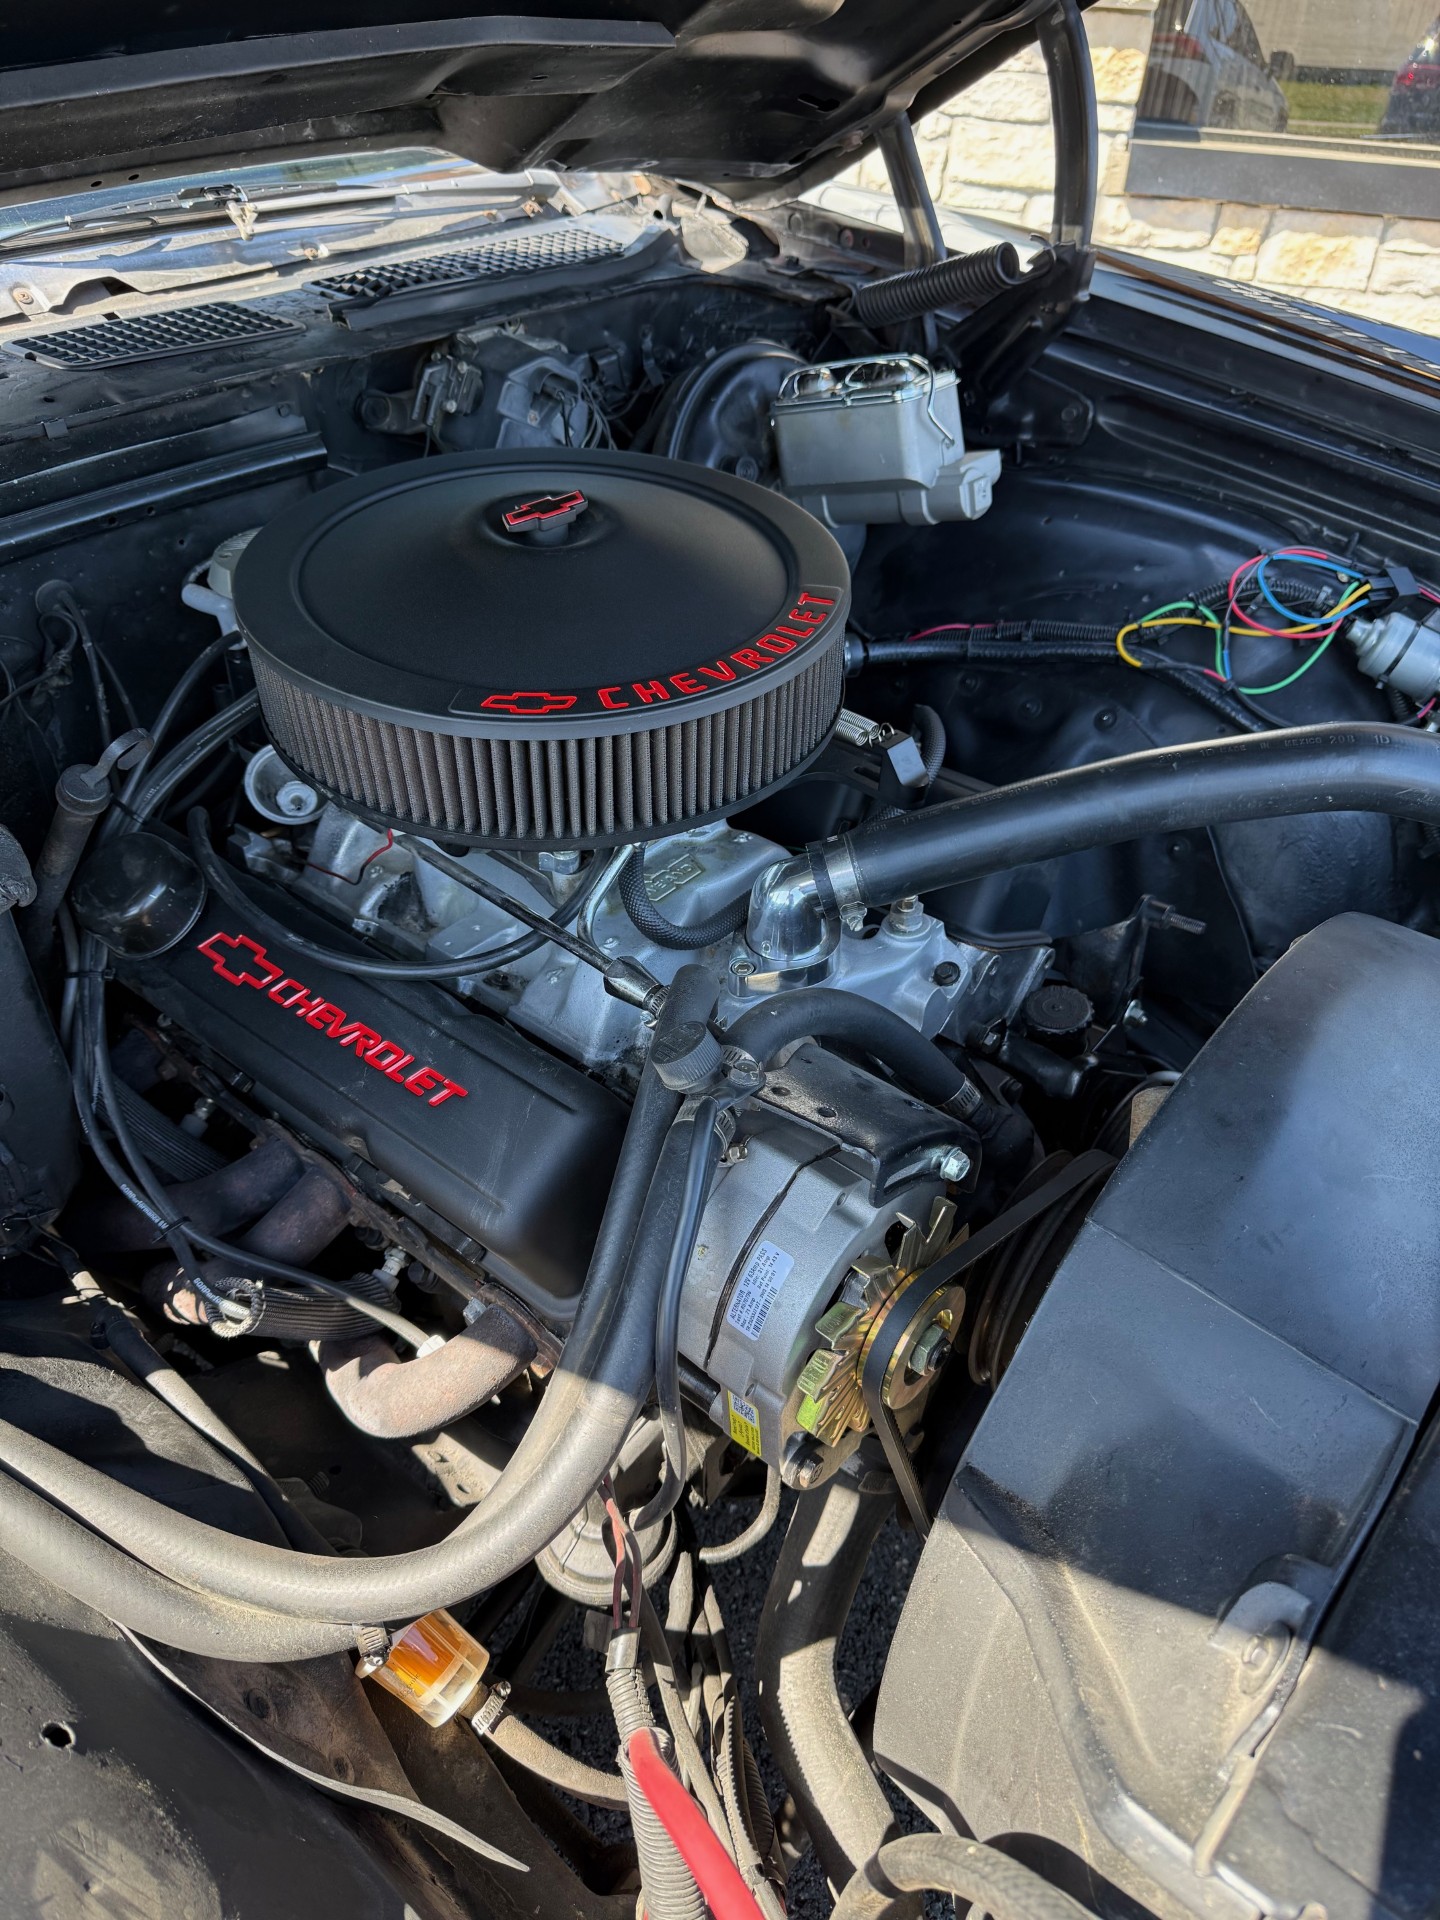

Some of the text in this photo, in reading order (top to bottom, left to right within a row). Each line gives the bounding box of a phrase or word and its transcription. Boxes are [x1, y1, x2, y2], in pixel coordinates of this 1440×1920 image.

[598, 592, 835, 709] CHEVROLET
[1284, 736, 1321, 747] MEXICO
[267, 978, 468, 1107] CHEVROLET
[730, 1289, 745, 1319] ALTERNATOR
[756, 1247, 767, 1261] PASS
